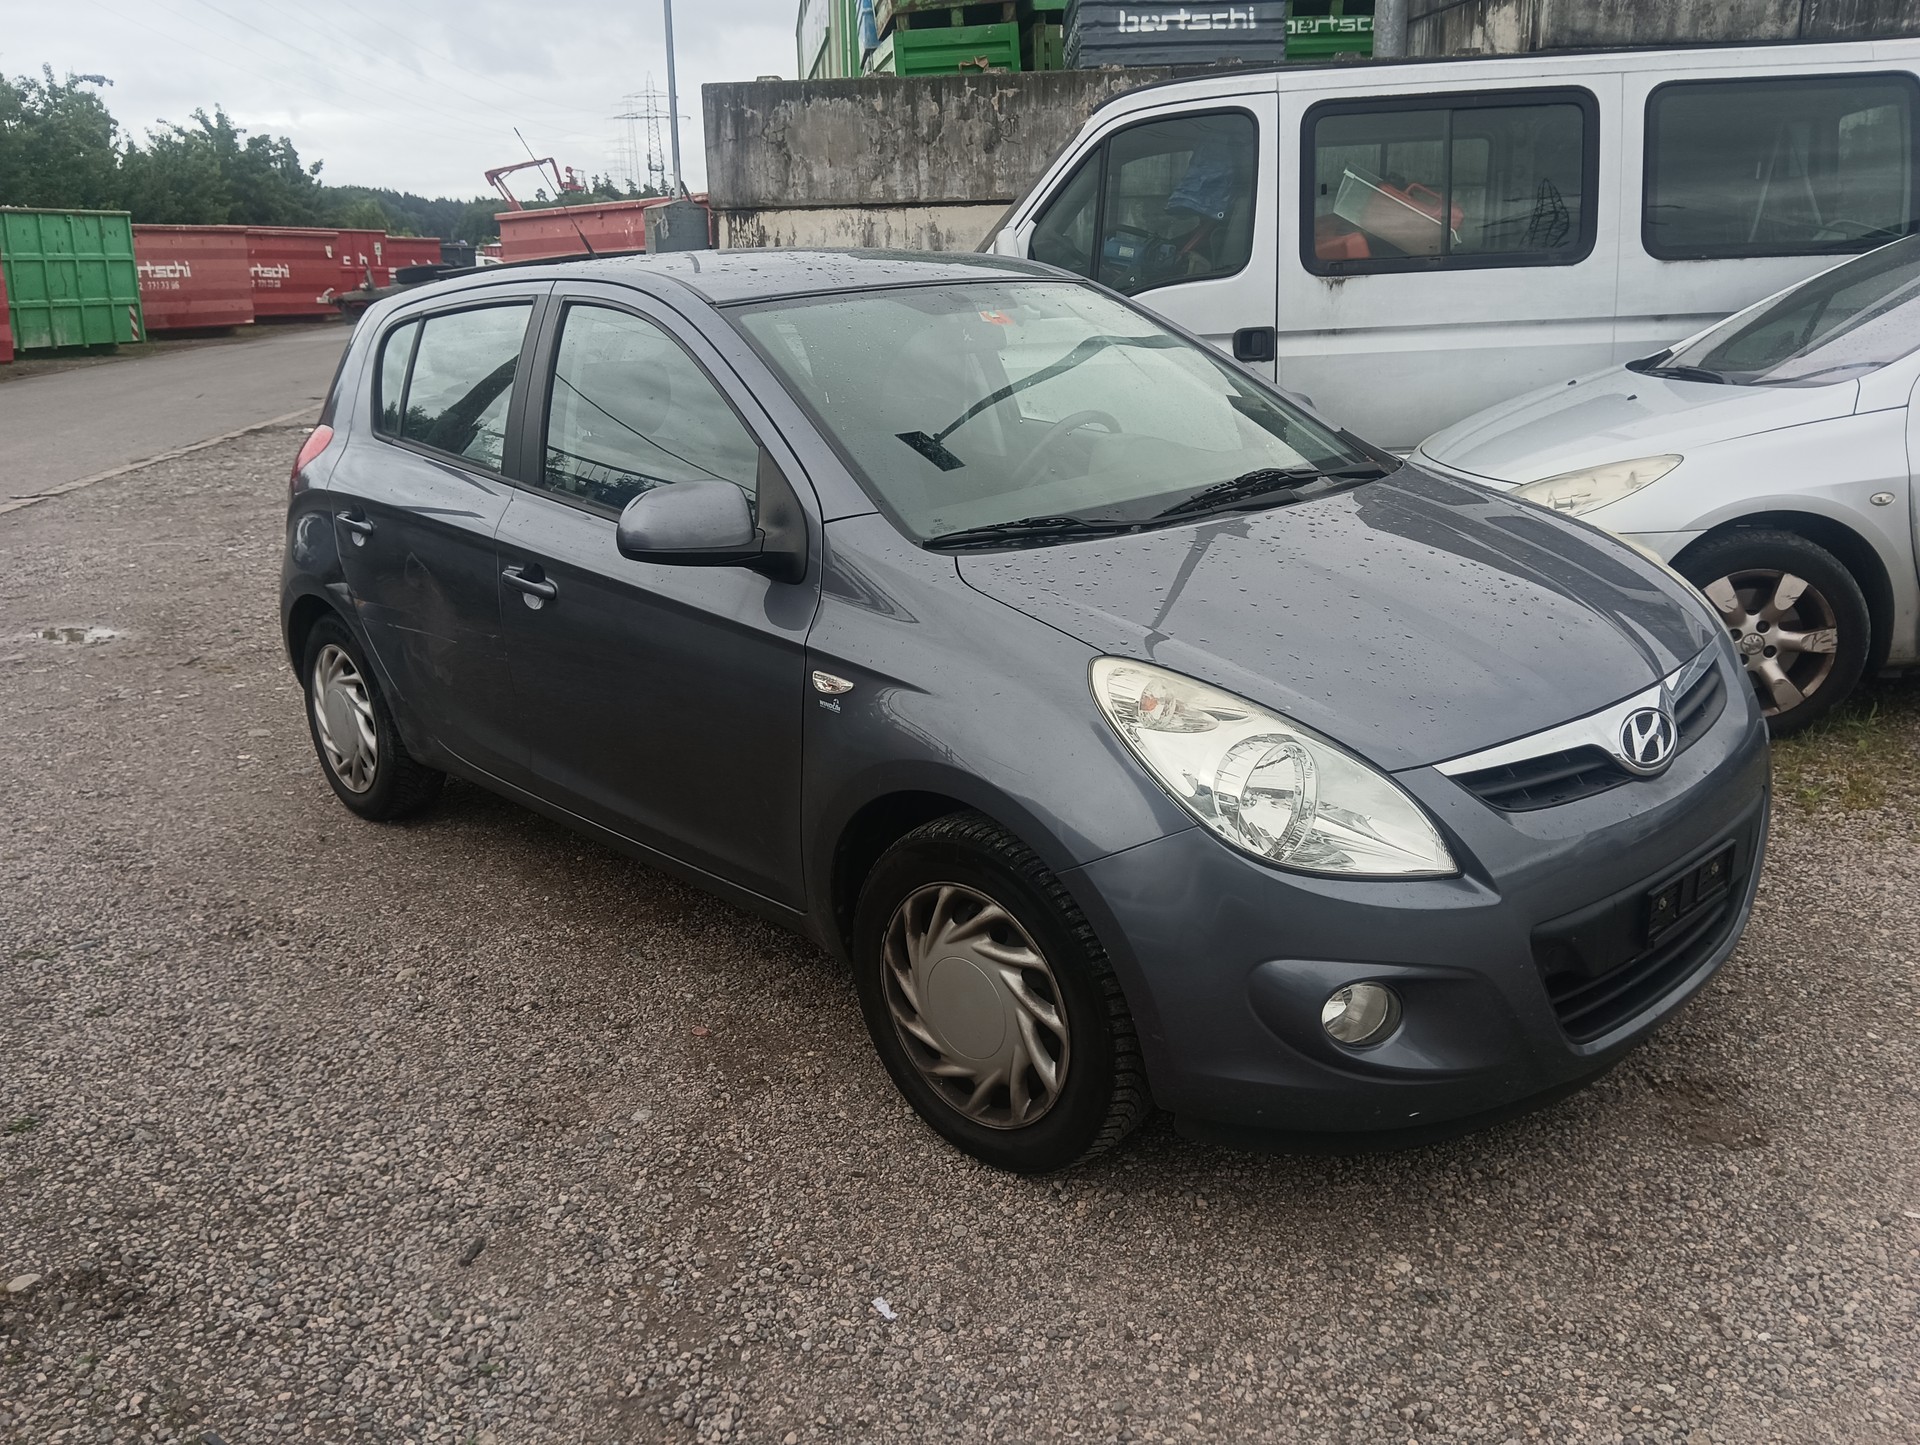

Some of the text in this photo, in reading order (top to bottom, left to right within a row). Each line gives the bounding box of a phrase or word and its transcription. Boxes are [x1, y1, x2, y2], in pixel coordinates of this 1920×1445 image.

[1118, 6, 1256, 33] bertschi
[1286, 15, 1374, 34] ertsc
[343, 252, 382, 266] chi
[136, 260, 192, 278] rtschi
[249, 262, 290, 278] rtschi
